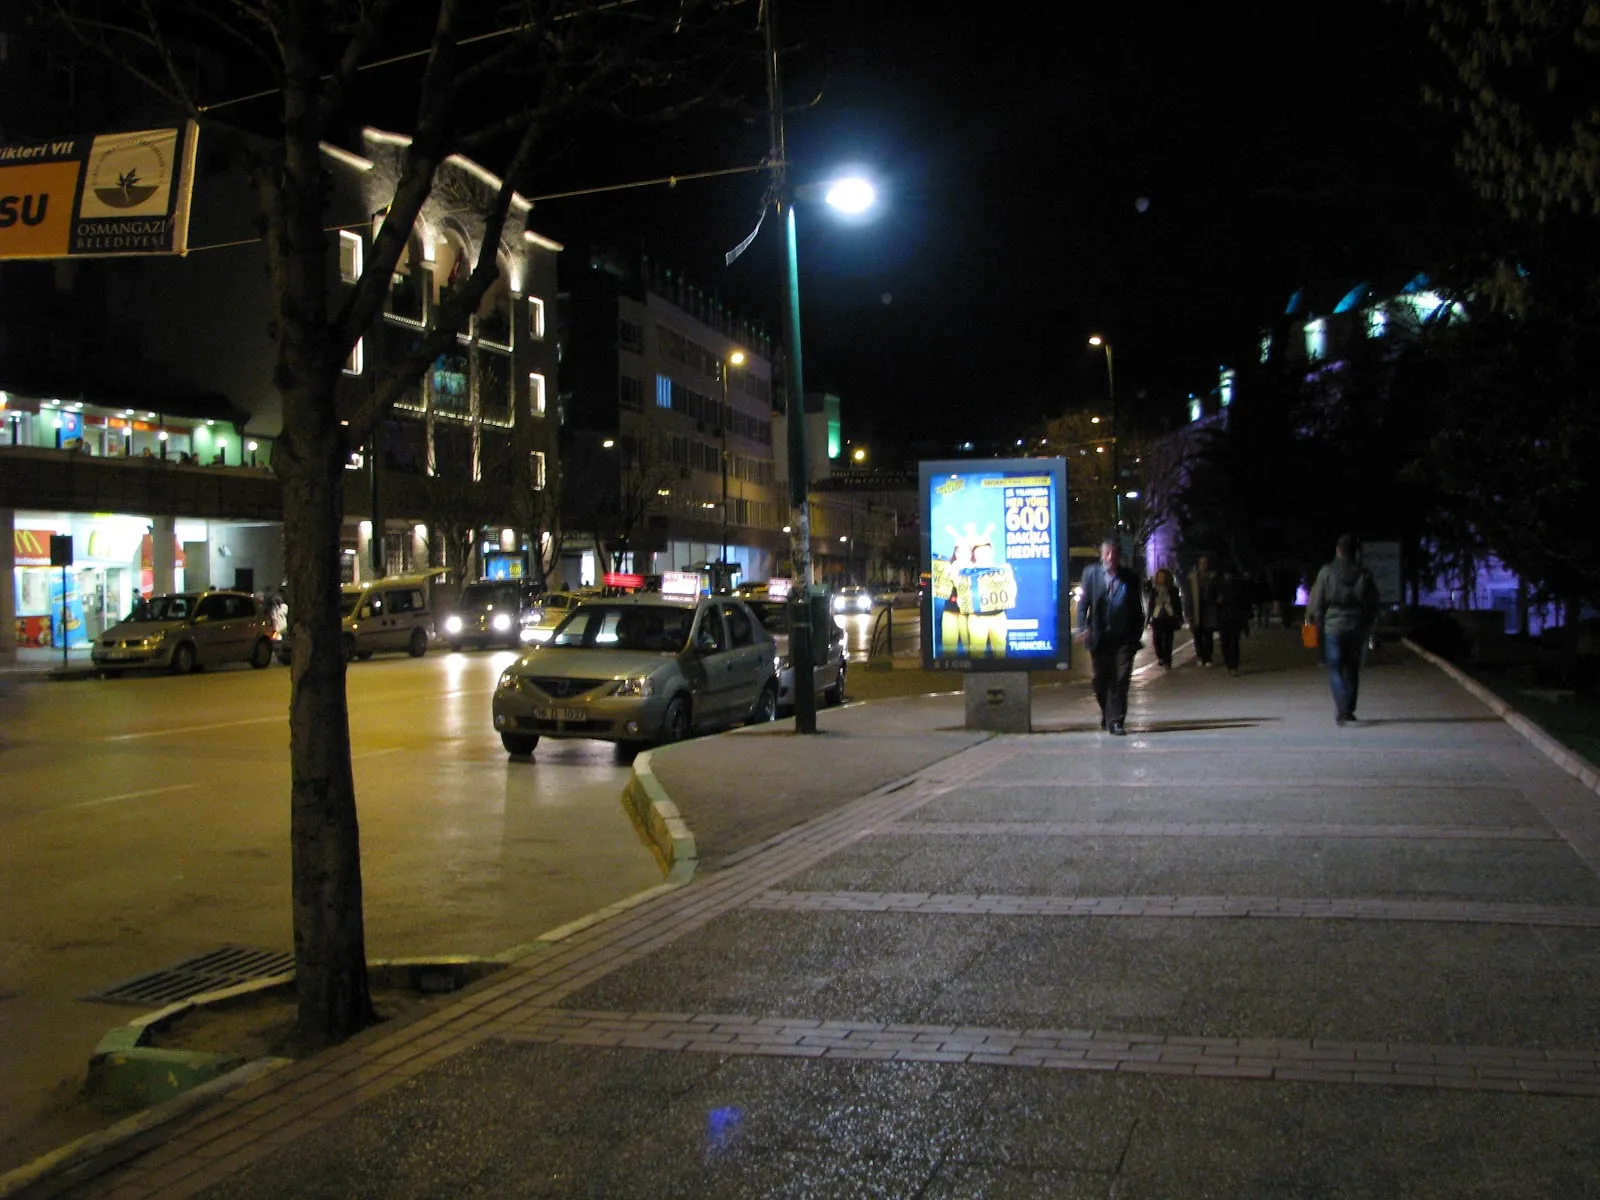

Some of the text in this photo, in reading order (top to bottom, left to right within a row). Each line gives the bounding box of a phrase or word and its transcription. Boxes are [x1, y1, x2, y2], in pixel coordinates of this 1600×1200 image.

[0, 144, 48, 160] ikleri
[1005, 506, 1050, 531] 600
[980, 590, 1008, 605] 600
